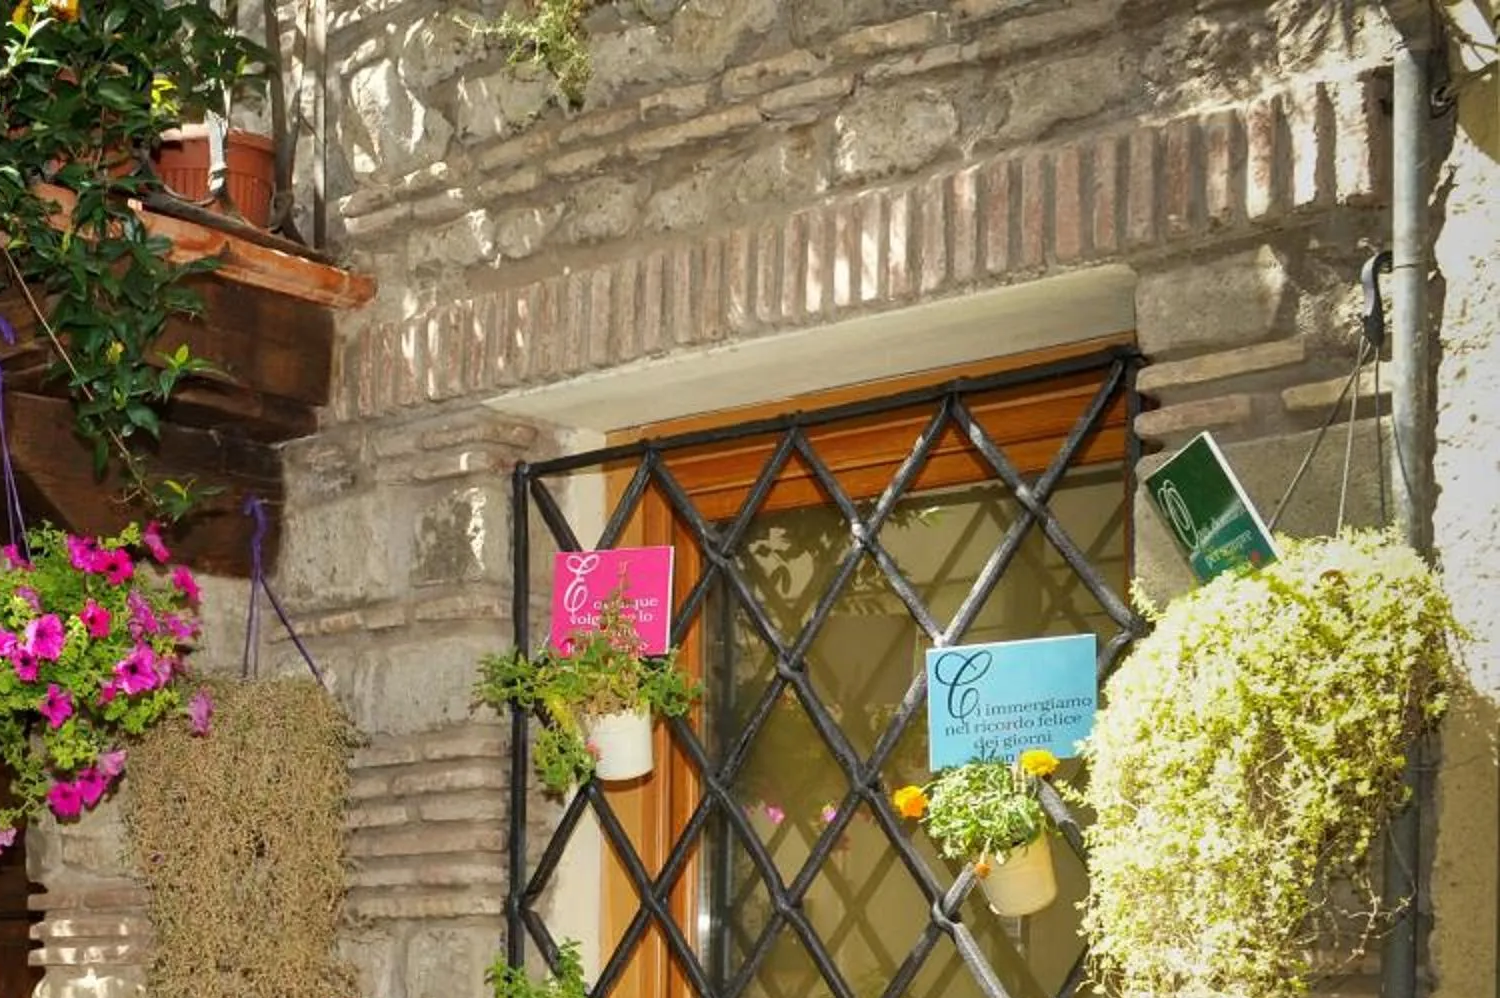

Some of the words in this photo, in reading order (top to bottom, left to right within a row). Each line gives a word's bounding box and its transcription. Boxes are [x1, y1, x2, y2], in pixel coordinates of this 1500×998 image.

[638, 609, 654, 623] lo
[985, 696, 1093, 717] immergiamo
[945, 722, 970, 737] nel
[973, 715, 1035, 734] ricordo
[1038, 713, 1082, 729] felice
[973, 735, 999, 749] dei
[1004, 731, 1052, 749] giorni
